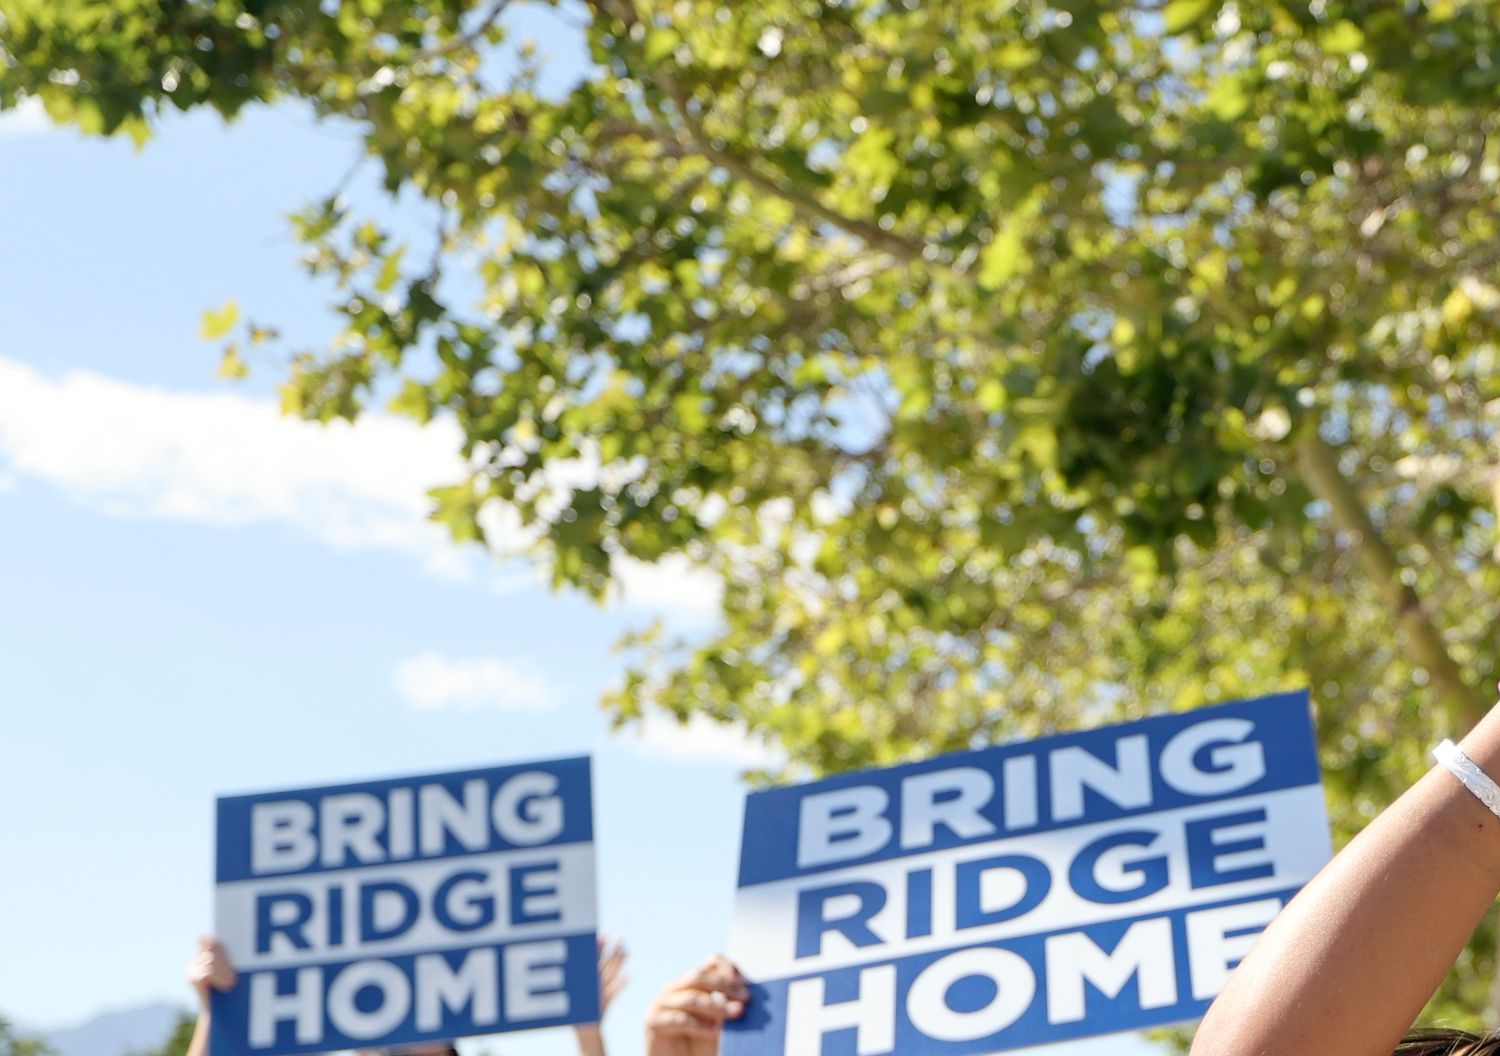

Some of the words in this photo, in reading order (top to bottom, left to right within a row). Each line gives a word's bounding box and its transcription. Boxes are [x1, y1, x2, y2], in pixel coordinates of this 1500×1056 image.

[250, 771, 565, 875] BRING
[798, 718, 1267, 868] BRING
[254, 859, 563, 957] RIDGE
[795, 807, 1276, 959] RIDGE
[248, 939, 571, 1049] HOME
